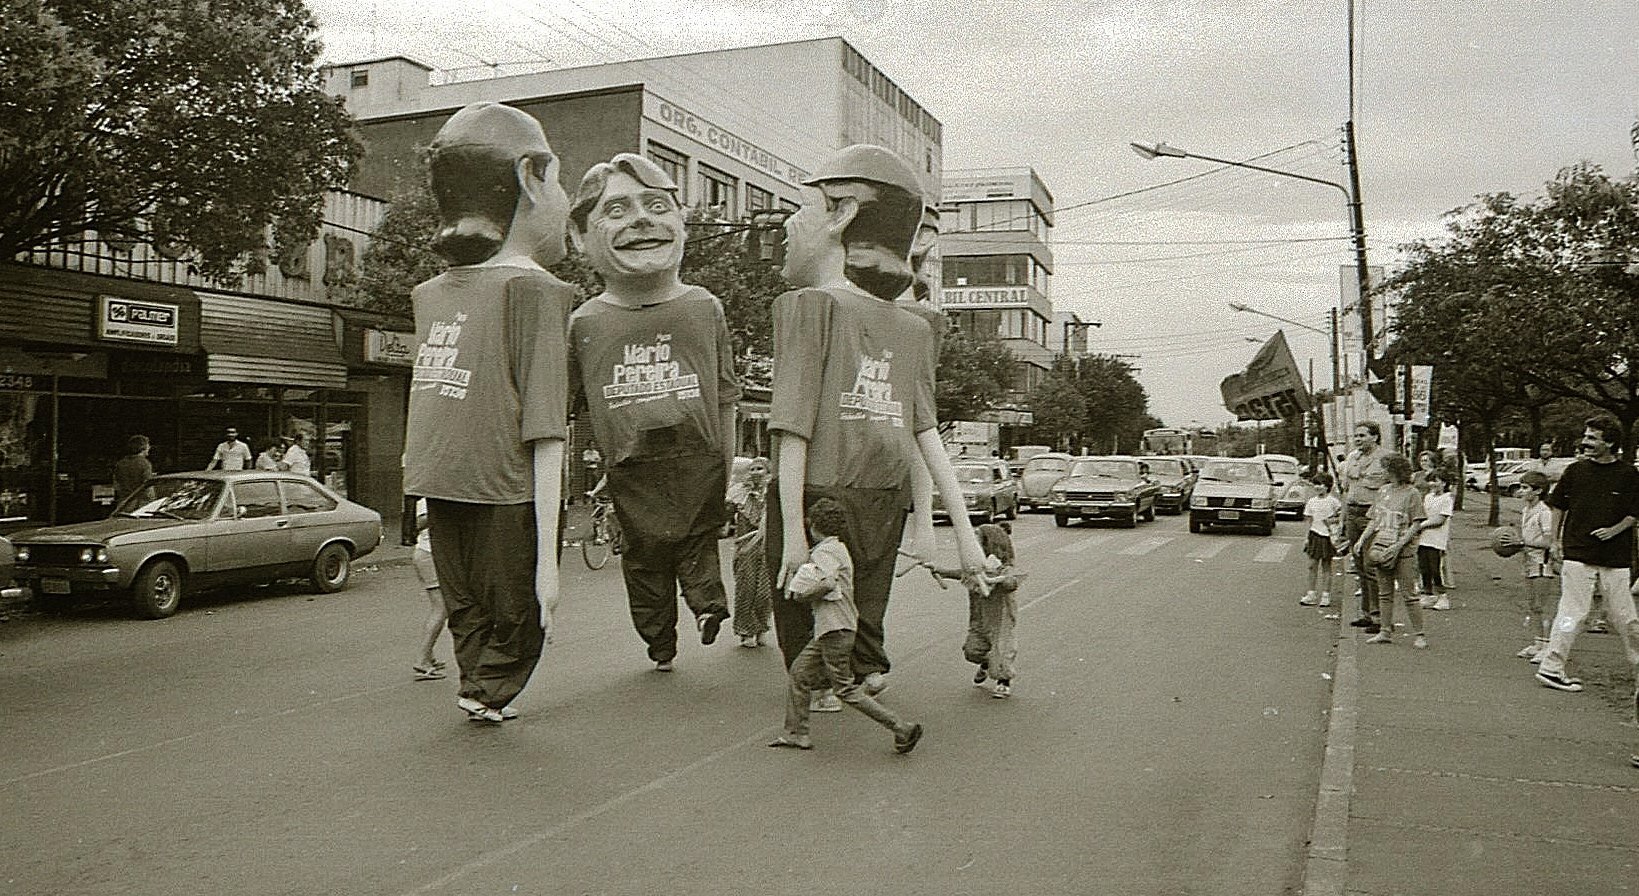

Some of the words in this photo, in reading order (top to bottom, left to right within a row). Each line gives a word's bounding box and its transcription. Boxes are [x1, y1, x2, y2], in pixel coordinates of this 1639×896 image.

[706, 126, 783, 177] CONTABIL
[968, 289, 1029, 304] CENTRAL
[612, 361, 680, 385] Pereira
